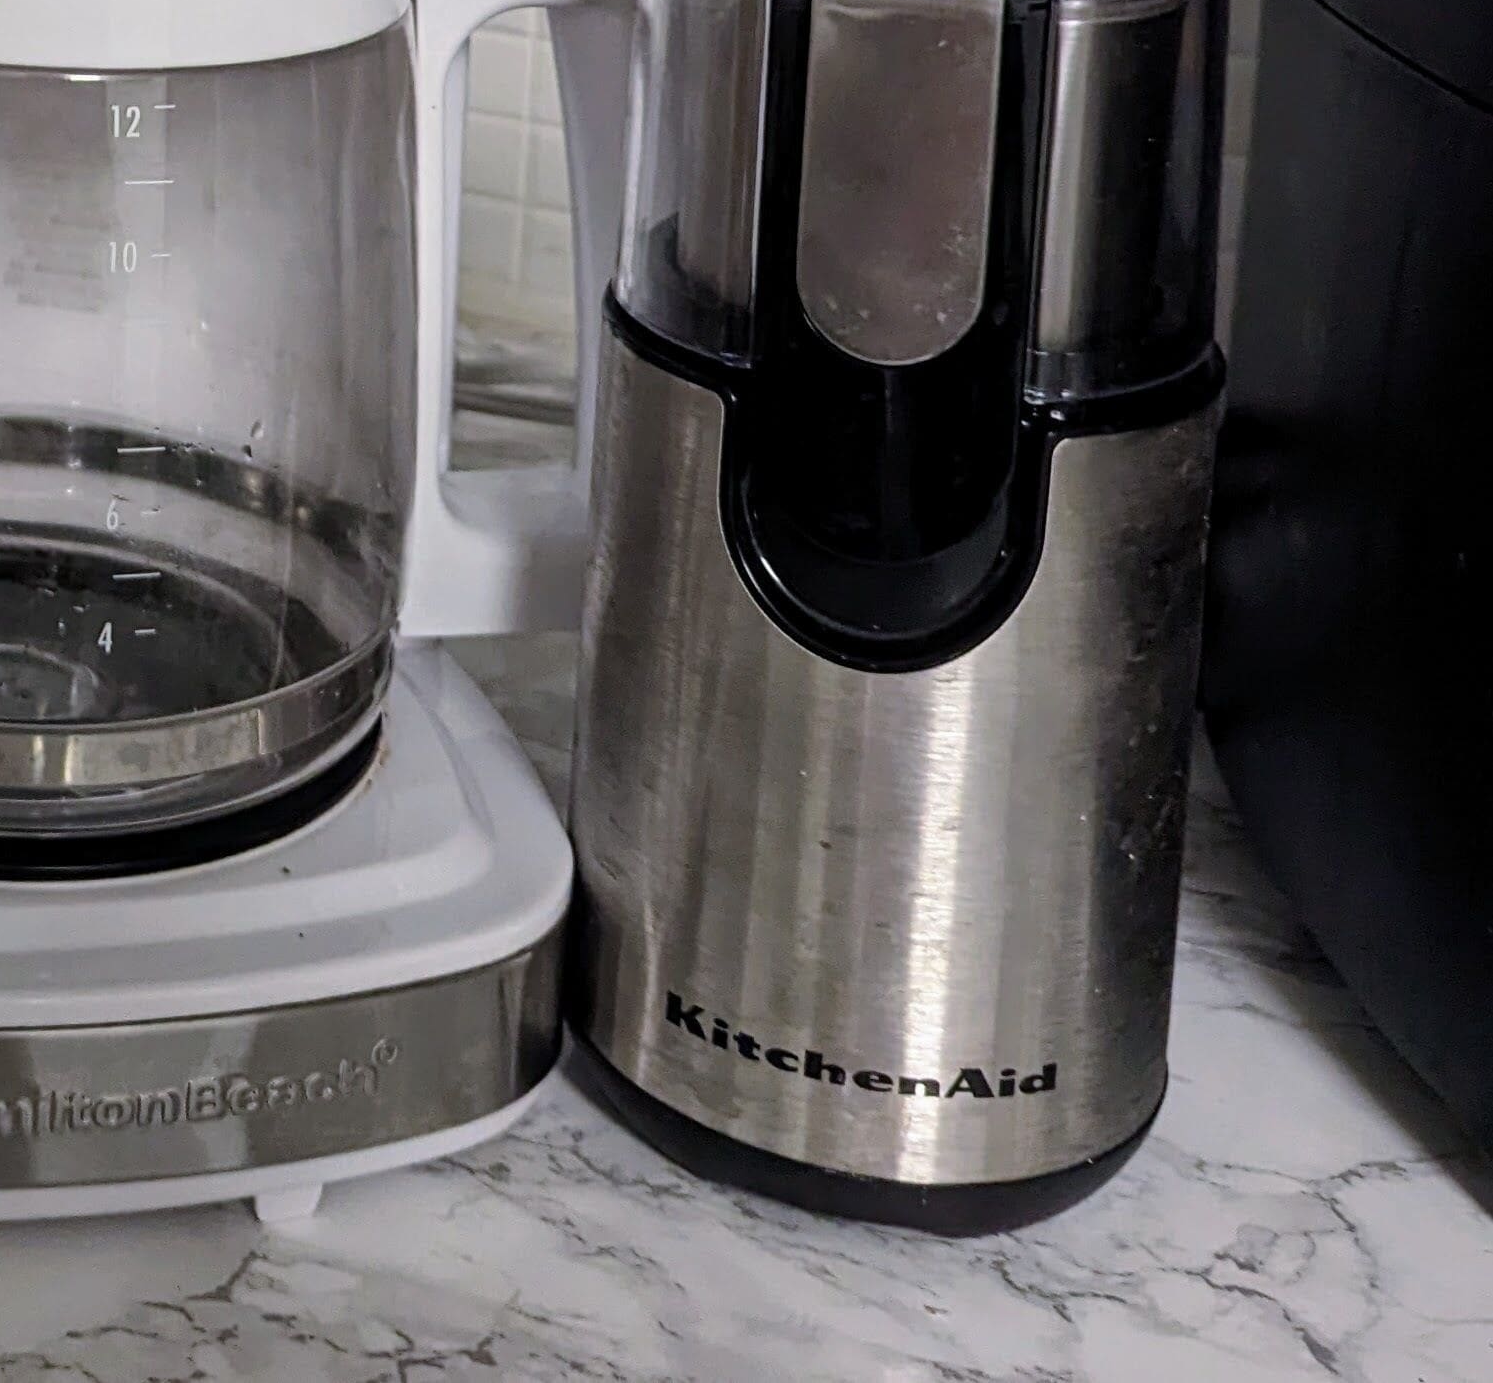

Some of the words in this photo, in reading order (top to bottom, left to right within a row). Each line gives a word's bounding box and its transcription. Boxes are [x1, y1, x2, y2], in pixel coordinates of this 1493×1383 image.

[110, 104, 141, 139] 12
[108, 241, 137, 273] 10
[107, 497, 119, 530] 6
[97, 622, 113, 654] 4
[665, 989, 1058, 1099] KitchenAid
